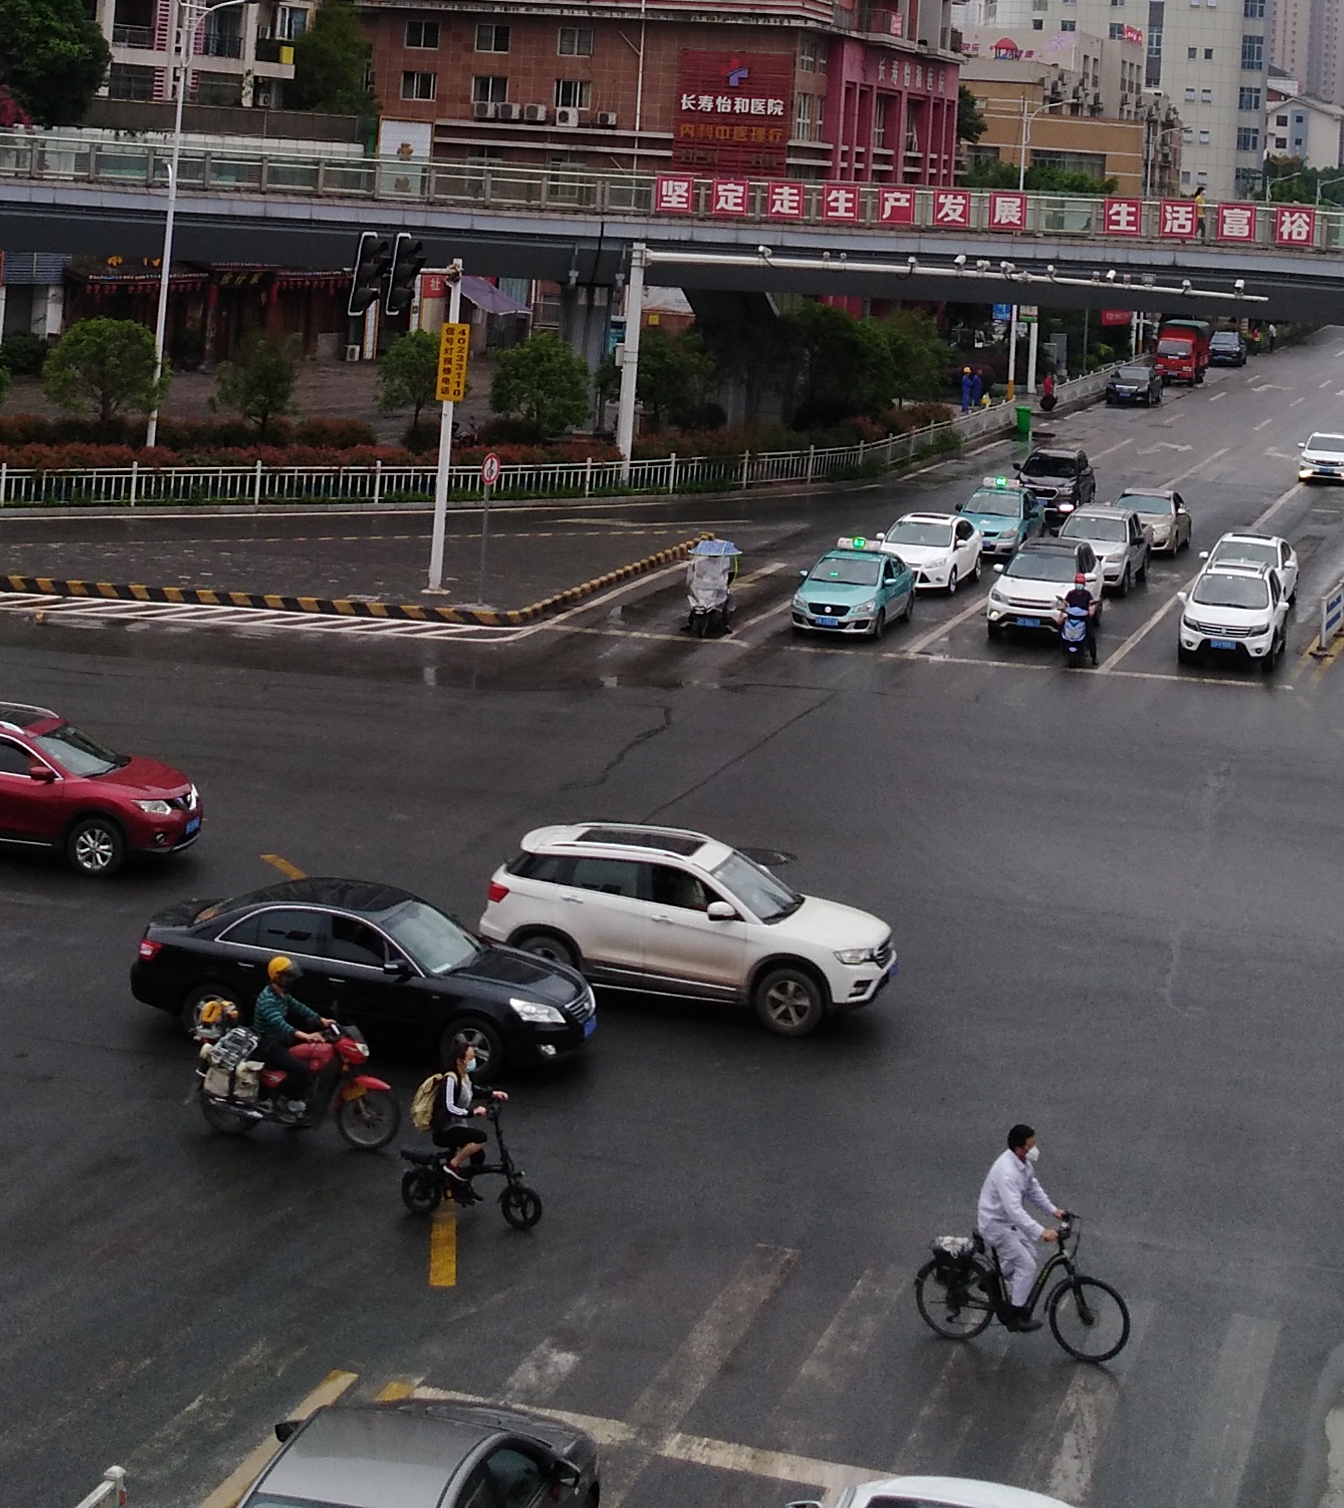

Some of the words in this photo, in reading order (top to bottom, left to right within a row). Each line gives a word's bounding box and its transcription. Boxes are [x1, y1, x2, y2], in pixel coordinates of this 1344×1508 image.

[681, 94, 785, 116] 长寿怡和医院
[680, 123, 784, 143] 内科中医理疗
[661, 180, 1022, 225] 坚定走生产发展
[1108, 203, 1309, 240] 生活富裕
